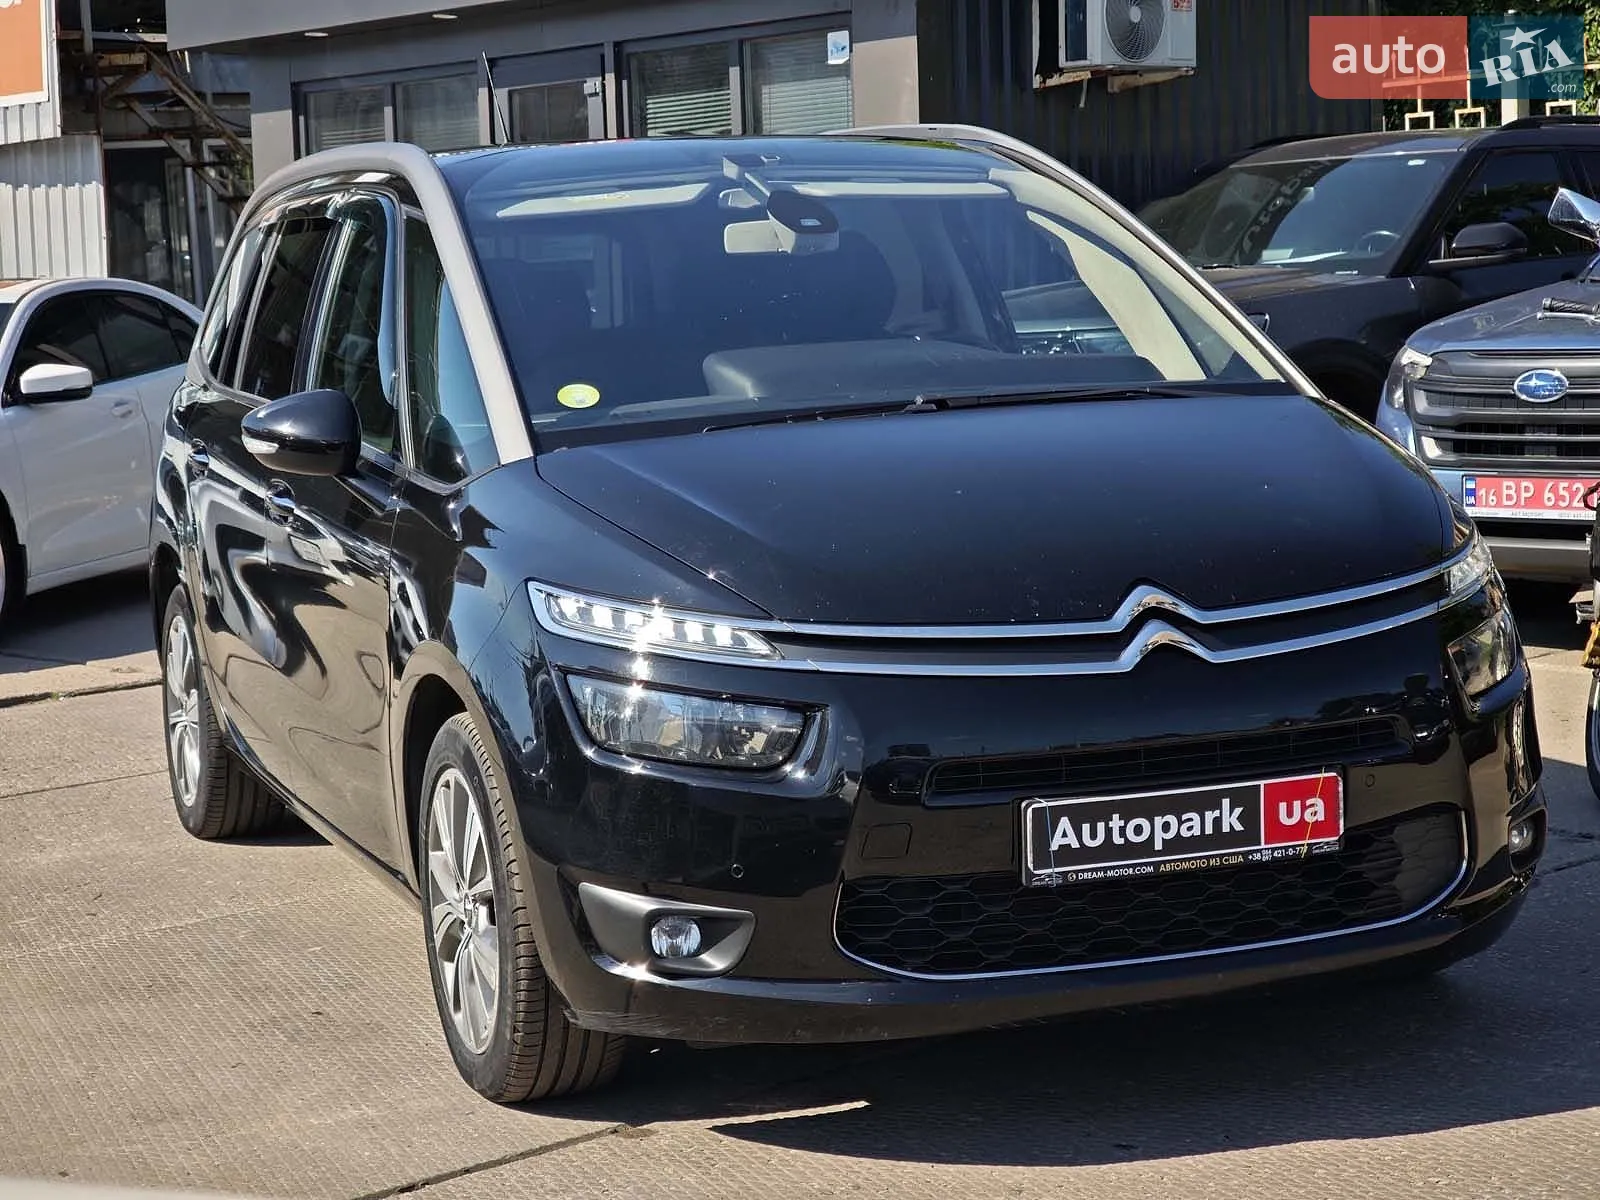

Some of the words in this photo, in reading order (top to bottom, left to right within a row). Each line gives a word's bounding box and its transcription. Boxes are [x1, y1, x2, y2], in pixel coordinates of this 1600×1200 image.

[1465, 496, 1476, 505] UA
[1480, 488, 1497, 506] 16
[1502, 481, 1534, 506] BP
[1050, 798, 1245, 850] Autopark
[1279, 797, 1325, 826] ua
[1209, 857, 1220, 866] ИЗ
[1223, 855, 1245, 865] США
[1078, 866, 1154, 880] DREAM-MOTOR.COM
